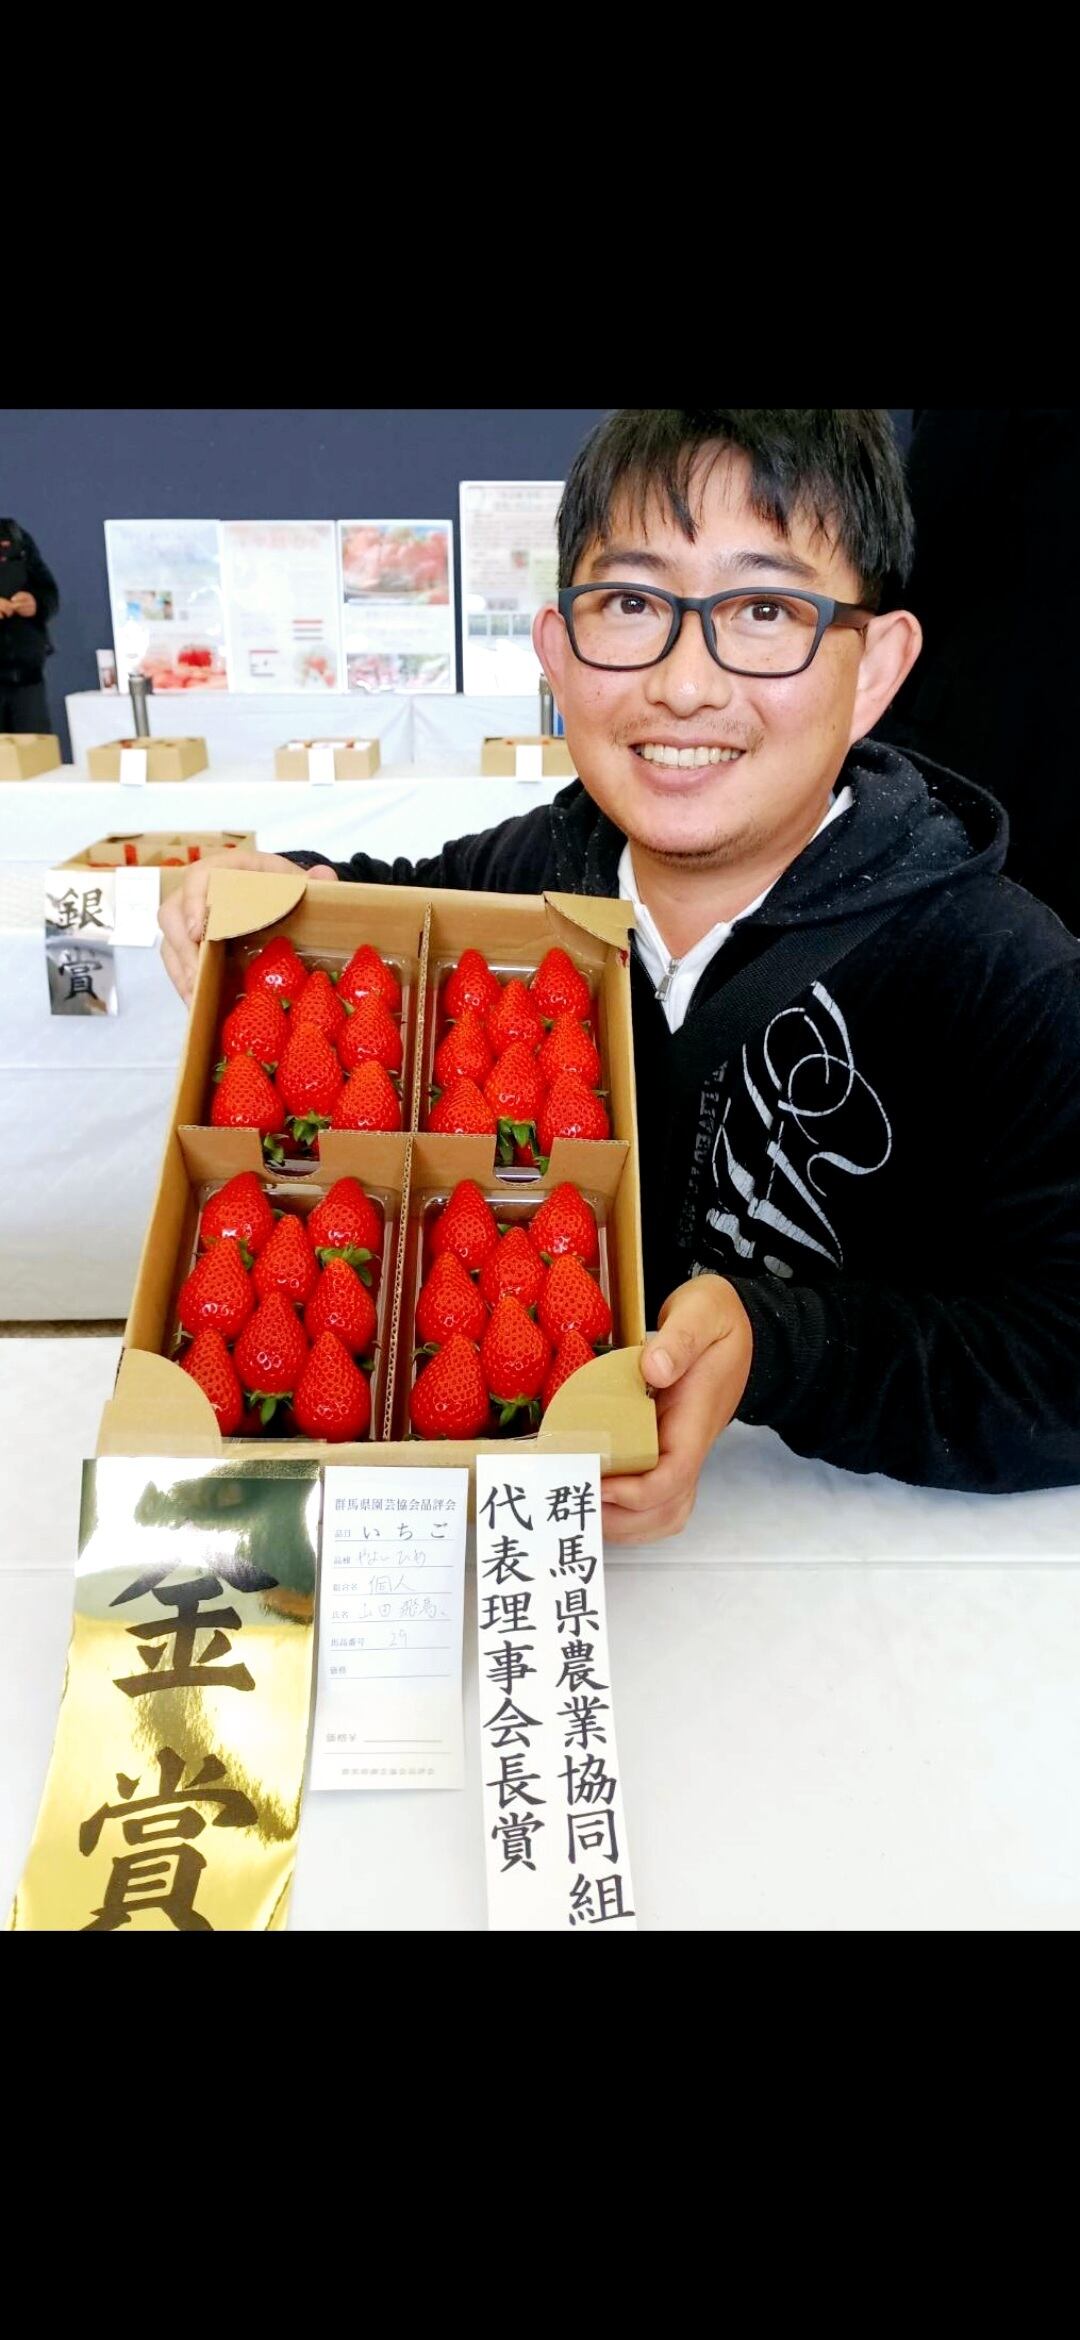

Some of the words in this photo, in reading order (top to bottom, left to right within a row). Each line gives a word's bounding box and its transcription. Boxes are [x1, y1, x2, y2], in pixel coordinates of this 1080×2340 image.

[57, 887, 105, 1000] 銀賞
[335, 1498, 457, 1511] 群馬県園芸協会品評会
[369, 1574, 416, 1595] 個人
[79, 1553, 279, 1931] 金賞
[479, 1482, 547, 1873] 代表理事会長賞
[545, 1481, 636, 1926] 群馬県農業協同組
